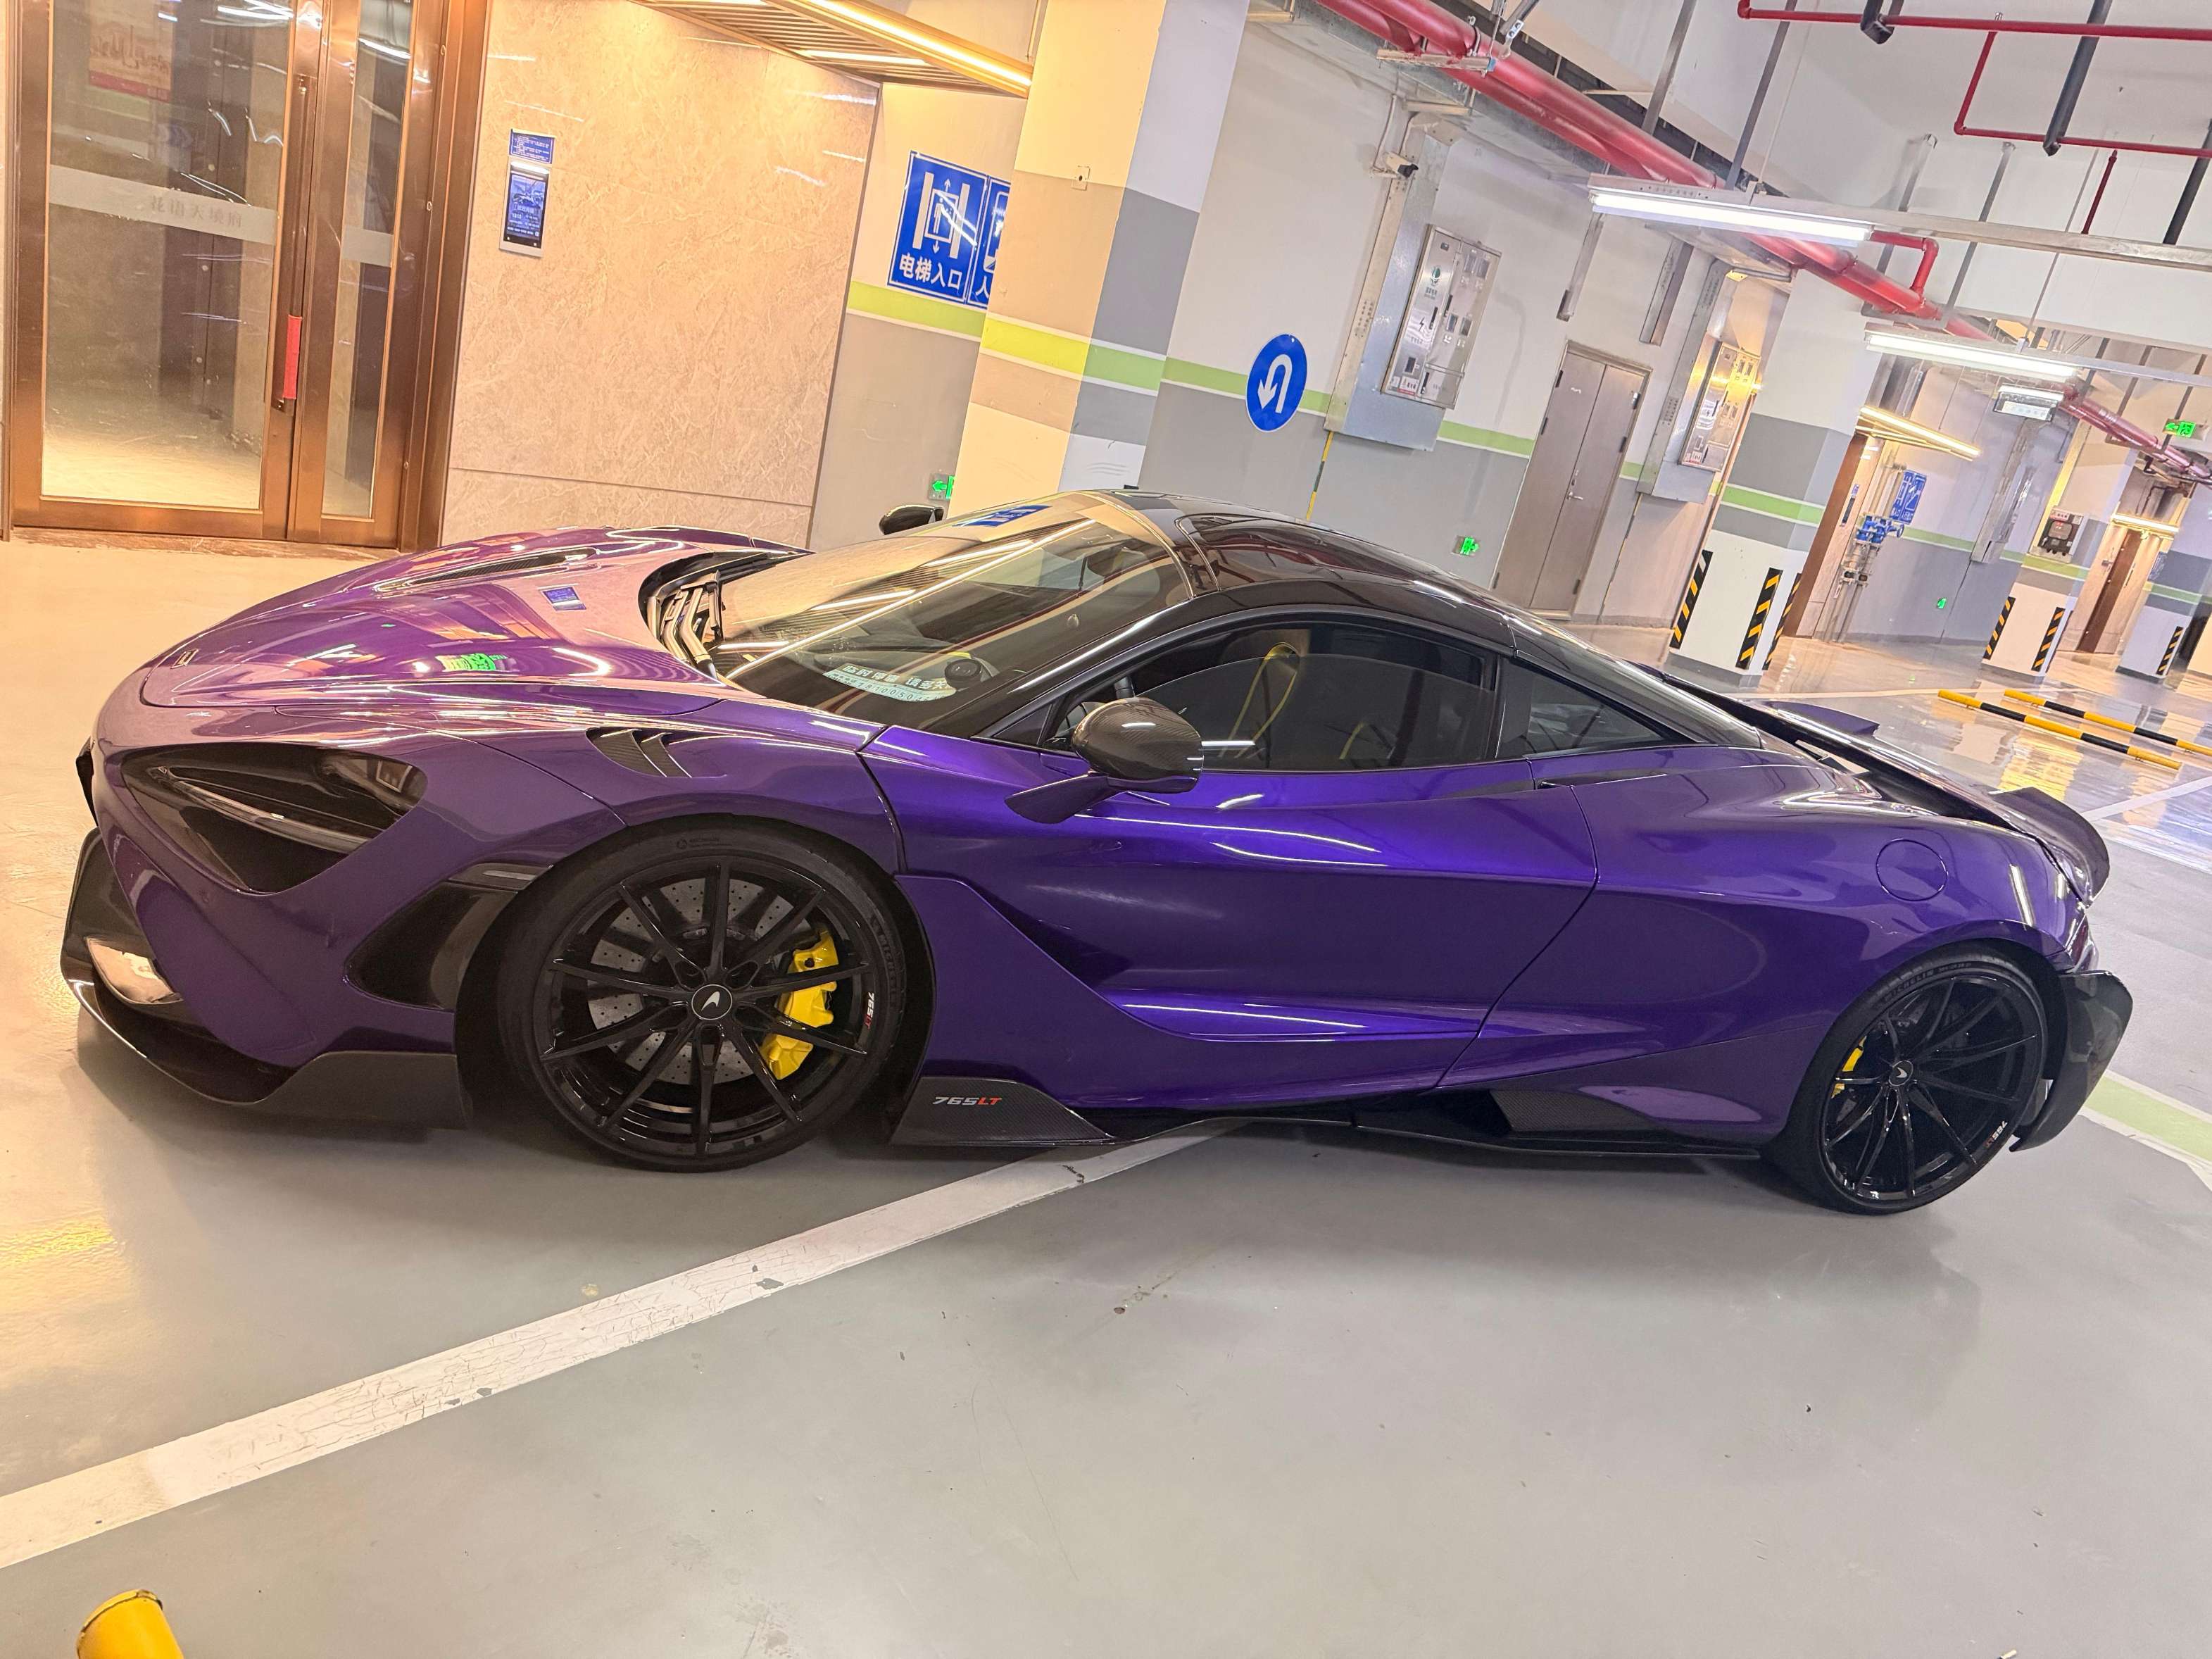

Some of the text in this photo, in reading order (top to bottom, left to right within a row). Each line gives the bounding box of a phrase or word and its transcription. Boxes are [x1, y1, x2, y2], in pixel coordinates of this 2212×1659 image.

[899, 253, 962, 290] 电梯入口
[864, 991, 874, 1031] 765LT
[932, 1096, 1003, 1106] 765LT
